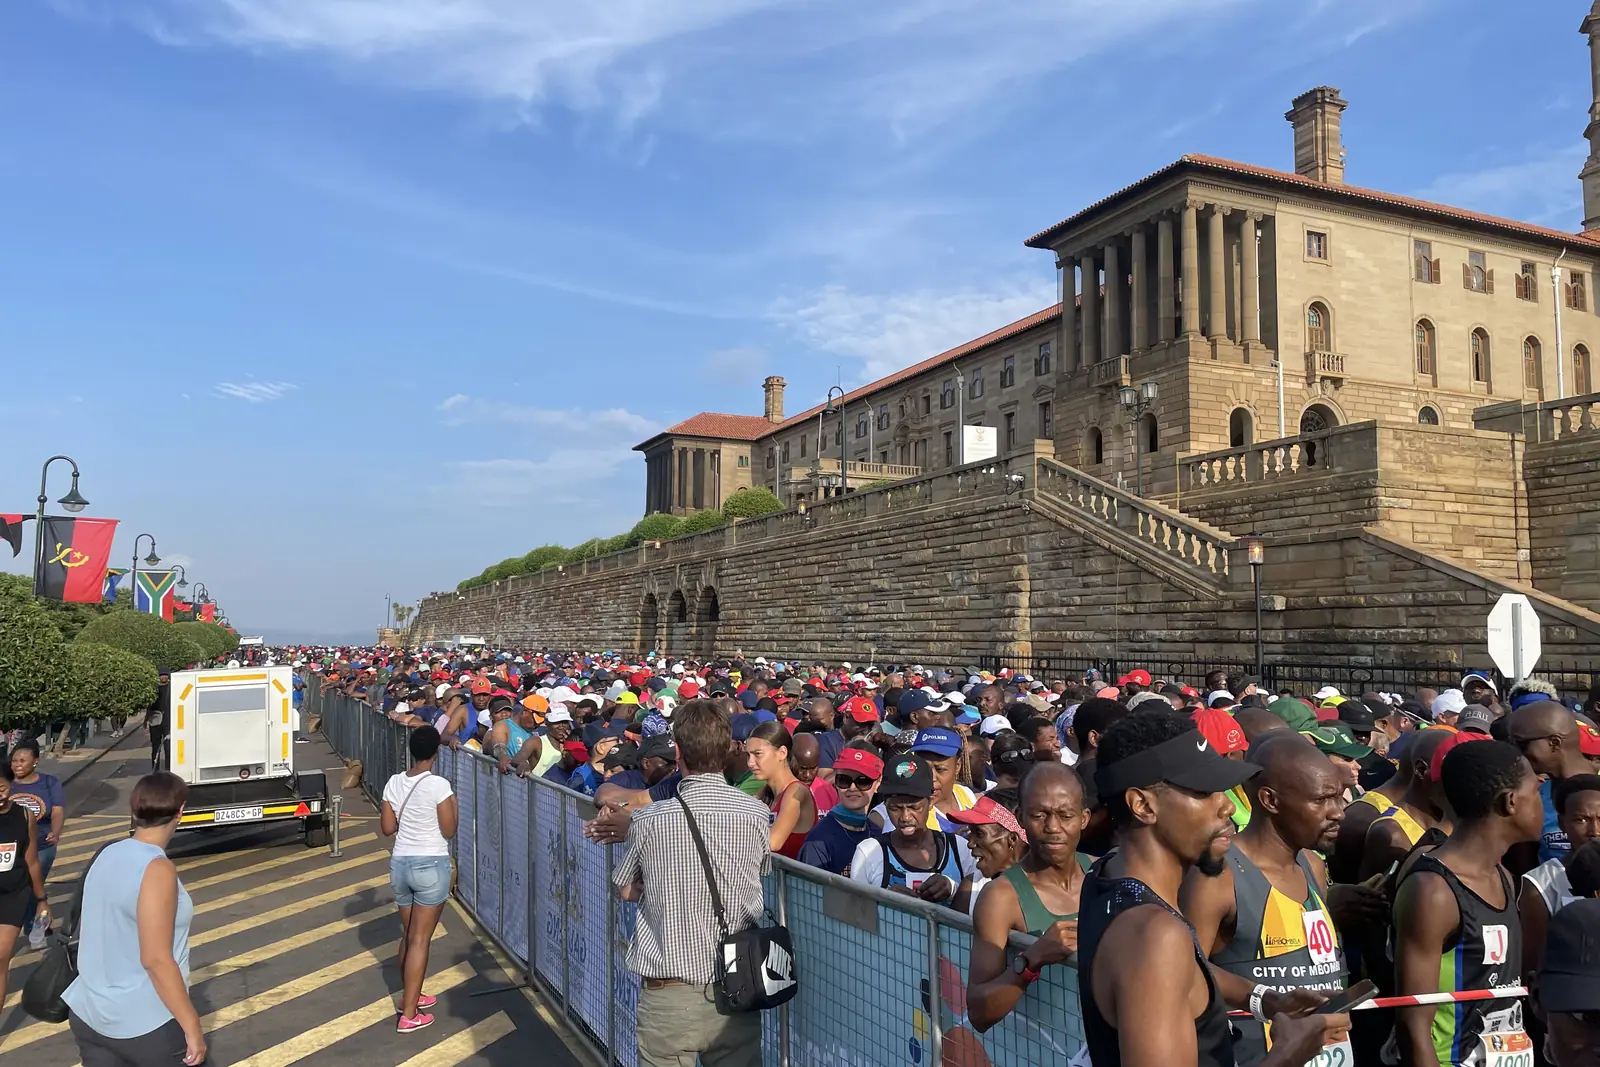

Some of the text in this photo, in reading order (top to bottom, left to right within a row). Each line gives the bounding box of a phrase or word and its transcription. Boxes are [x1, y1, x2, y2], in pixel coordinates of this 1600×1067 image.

[215, 807, 262, 821] DZ48CS GP
[1309, 919, 1333, 956] 40
[1252, 966, 1287, 978] CITY
[1291, 966, 1307, 977] OF
